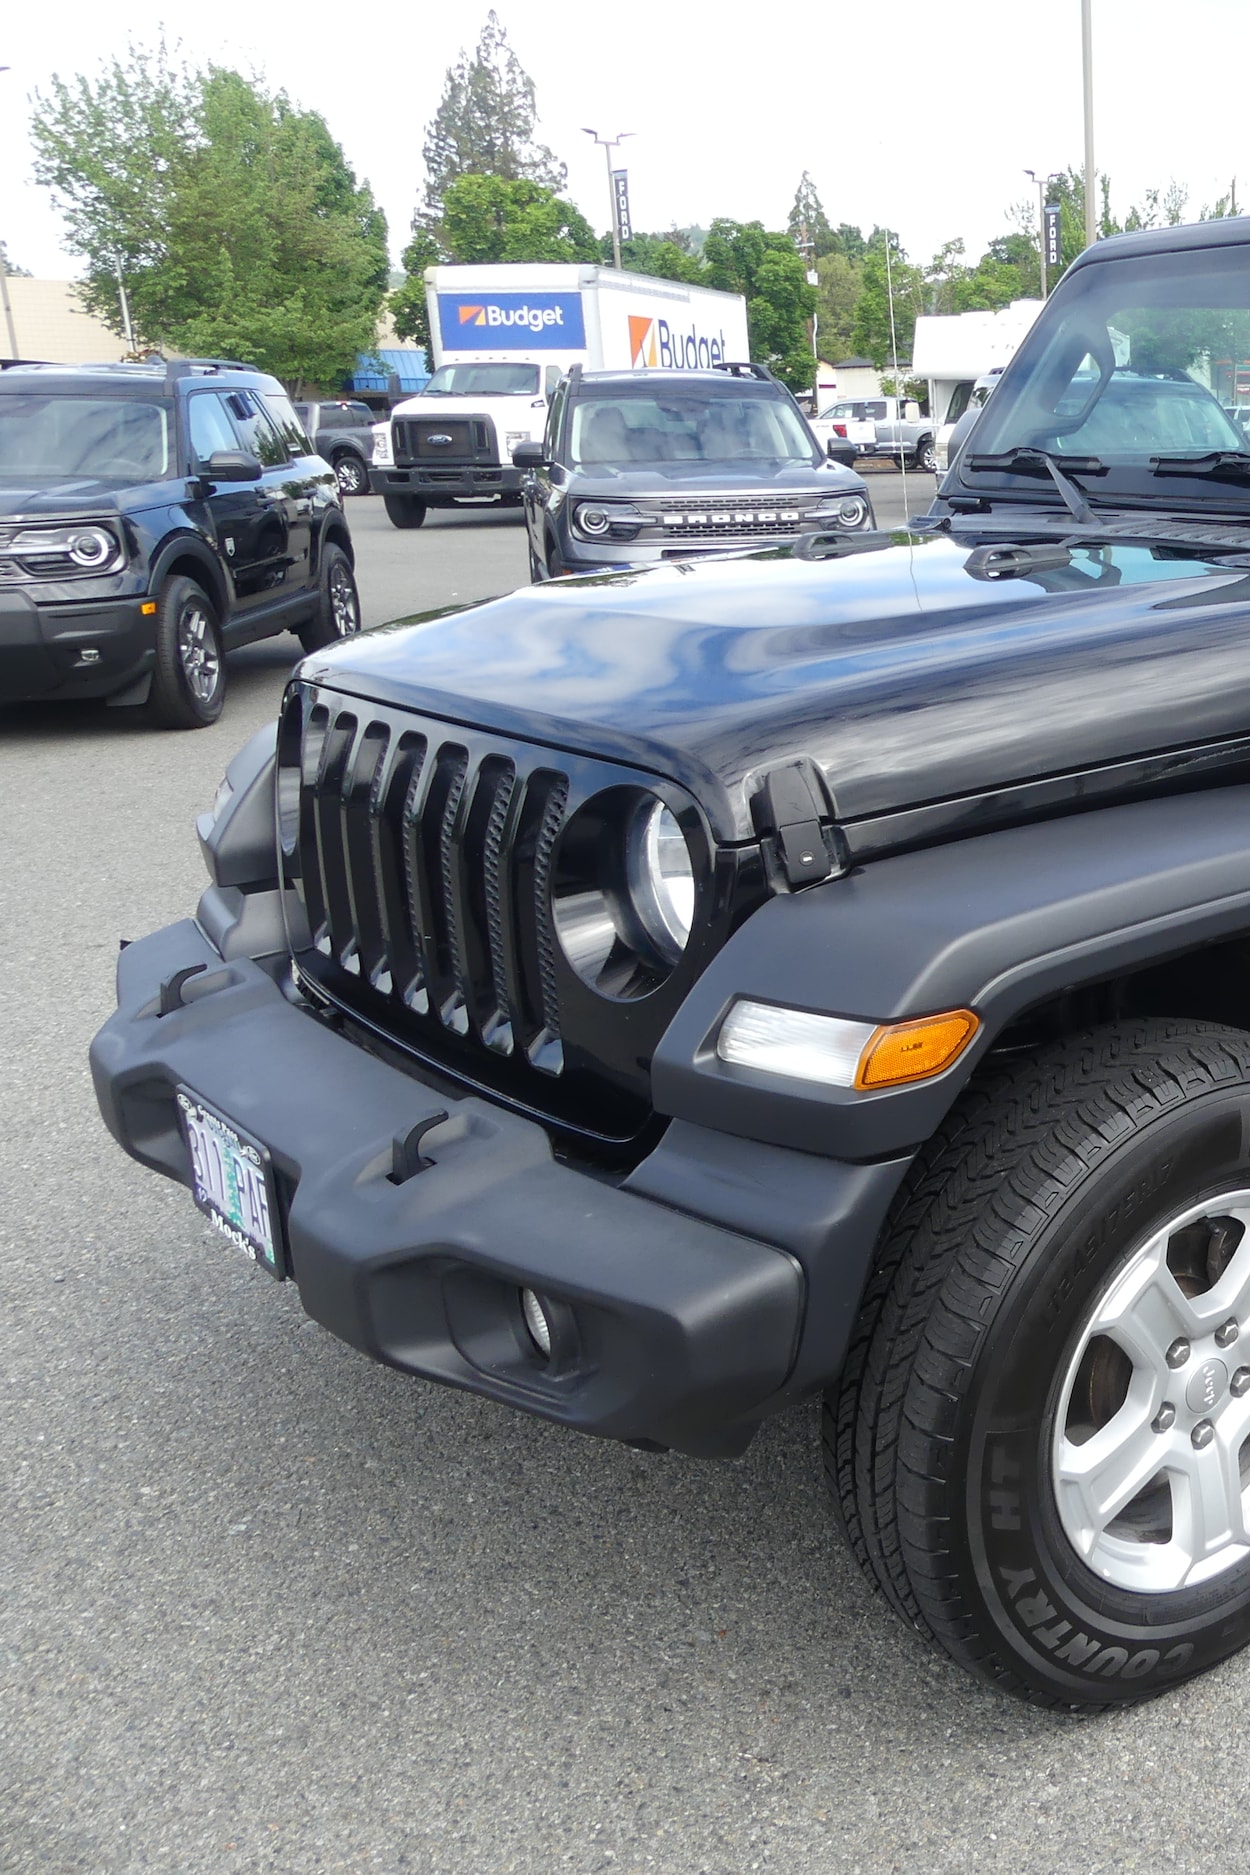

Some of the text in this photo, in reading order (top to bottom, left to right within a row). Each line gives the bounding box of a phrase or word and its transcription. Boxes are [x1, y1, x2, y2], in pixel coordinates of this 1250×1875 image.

[618, 180, 630, 240] FORD
[1048, 214, 1058, 264] FORD
[486, 305, 565, 333] Budget
[657, 318, 726, 369] Budget
[663, 511, 800, 525] BRONCO
[210, 1207, 257, 1261] Mock's
[999, 1566, 1195, 1679] COUNTRY
